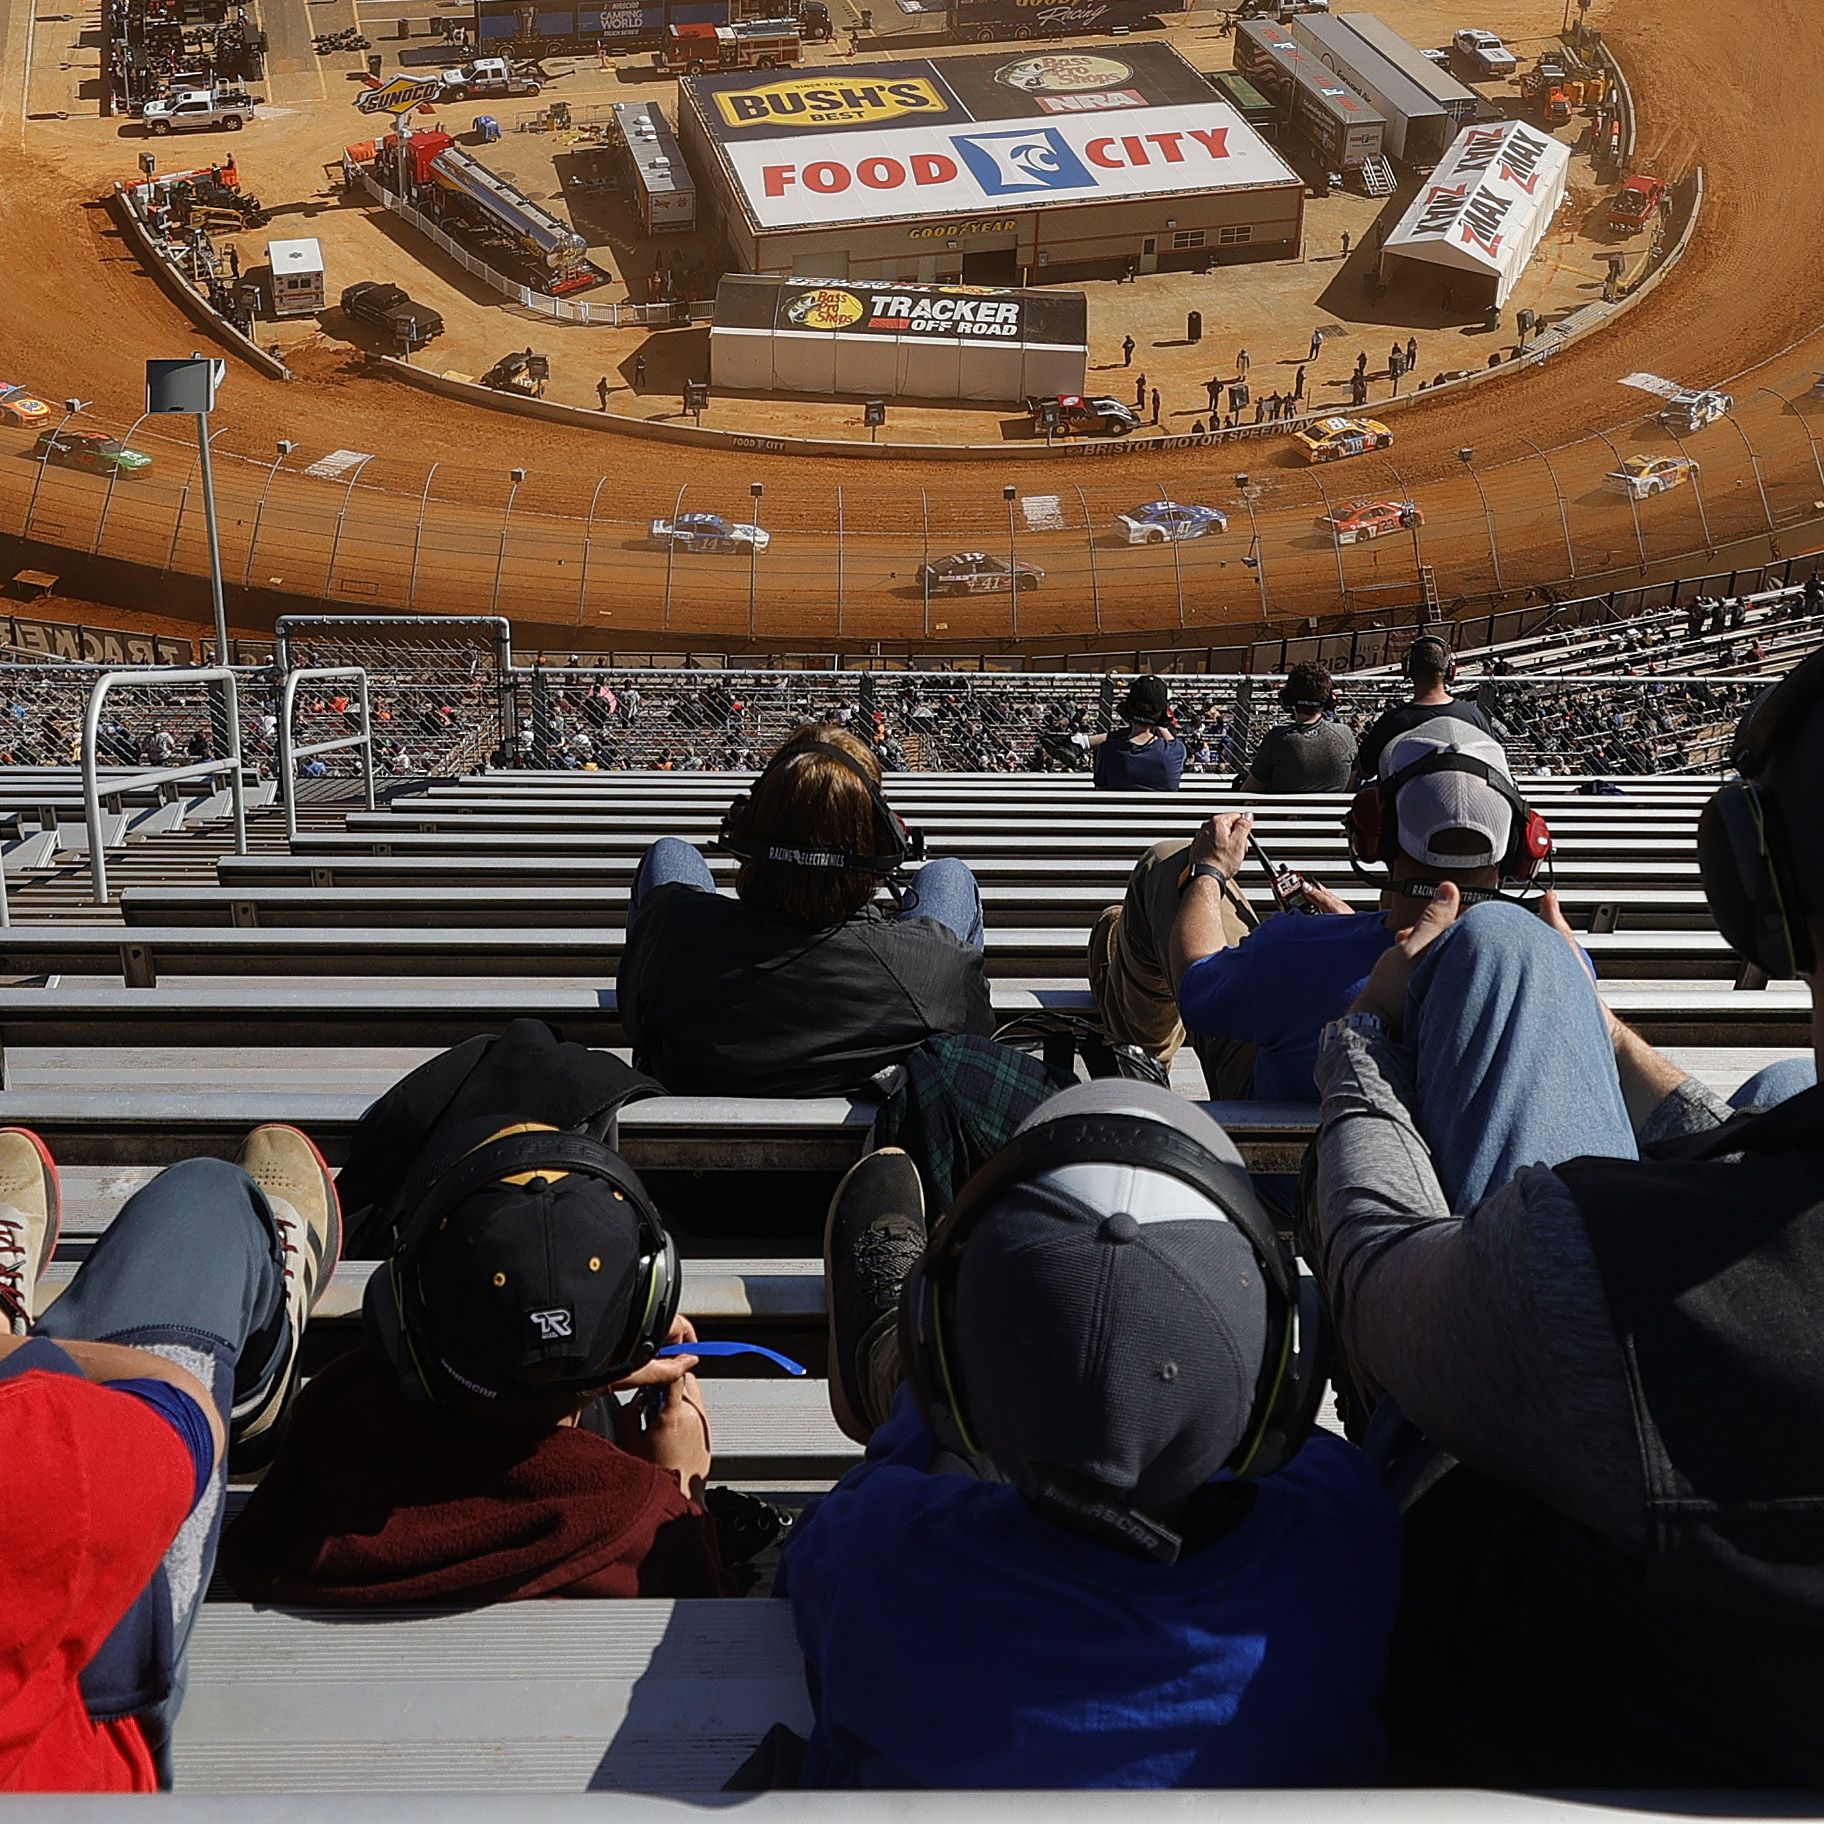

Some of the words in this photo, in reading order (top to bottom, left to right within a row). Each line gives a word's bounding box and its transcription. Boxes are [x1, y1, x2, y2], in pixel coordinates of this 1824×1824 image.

[600, 9, 643, 21] CAMPING
[1036, 3, 1111, 26] Racing
[601, 17, 643, 29] WORLD
[1040, 55, 1093, 70] Bass
[1055, 65, 1089, 78] Pro
[1058, 71, 1122, 89] Shops
[1336, 68, 1363, 97] Forward
[366, 79, 438, 112] SUNOCO
[729, 77, 933, 120] BUSH'S
[1048, 90, 1144, 110] NRA
[810, 111, 865, 123] BEST
[762, 153, 959, 197] FOOD
[1085, 127, 1231, 170] CITY
[909, 220, 1016, 240] GOODYEAR
[818, 290, 848, 304] Bass
[816, 302, 839, 314] Pro
[870, 295, 1020, 324] TRACKER
[816, 311, 854, 325] Shops
[911, 319, 952, 333] OFF
[957, 321, 1018, 336] ROAD
[732, 437, 755, 448] FOOD
[766, 440, 785, 450] CITY
[1084, 440, 1156, 456] BRISTOL
[1162, 434, 1224, 450] MOTOR
[1229, 419, 1316, 444] SPEEDWAY
[1351, 438, 1364, 452] 18
[1177, 521, 1193, 534] 47
[982, 576, 1001, 590] 41
